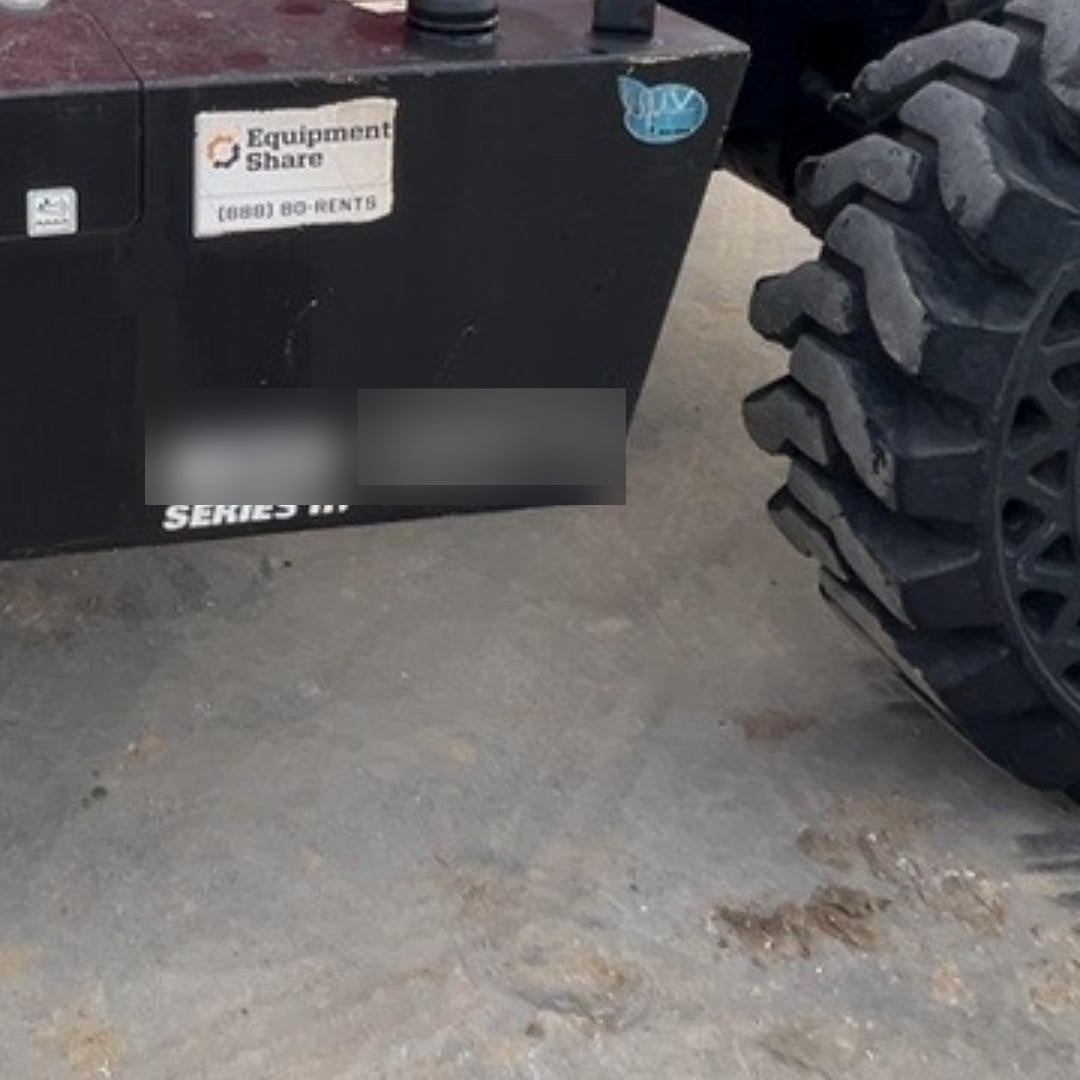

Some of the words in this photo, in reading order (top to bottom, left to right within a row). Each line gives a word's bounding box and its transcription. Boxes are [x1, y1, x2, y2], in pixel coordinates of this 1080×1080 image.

[246, 122, 392, 151] Equipment
[246, 151, 324, 172] Share
[281, 194, 377, 217] 80-RENTS
